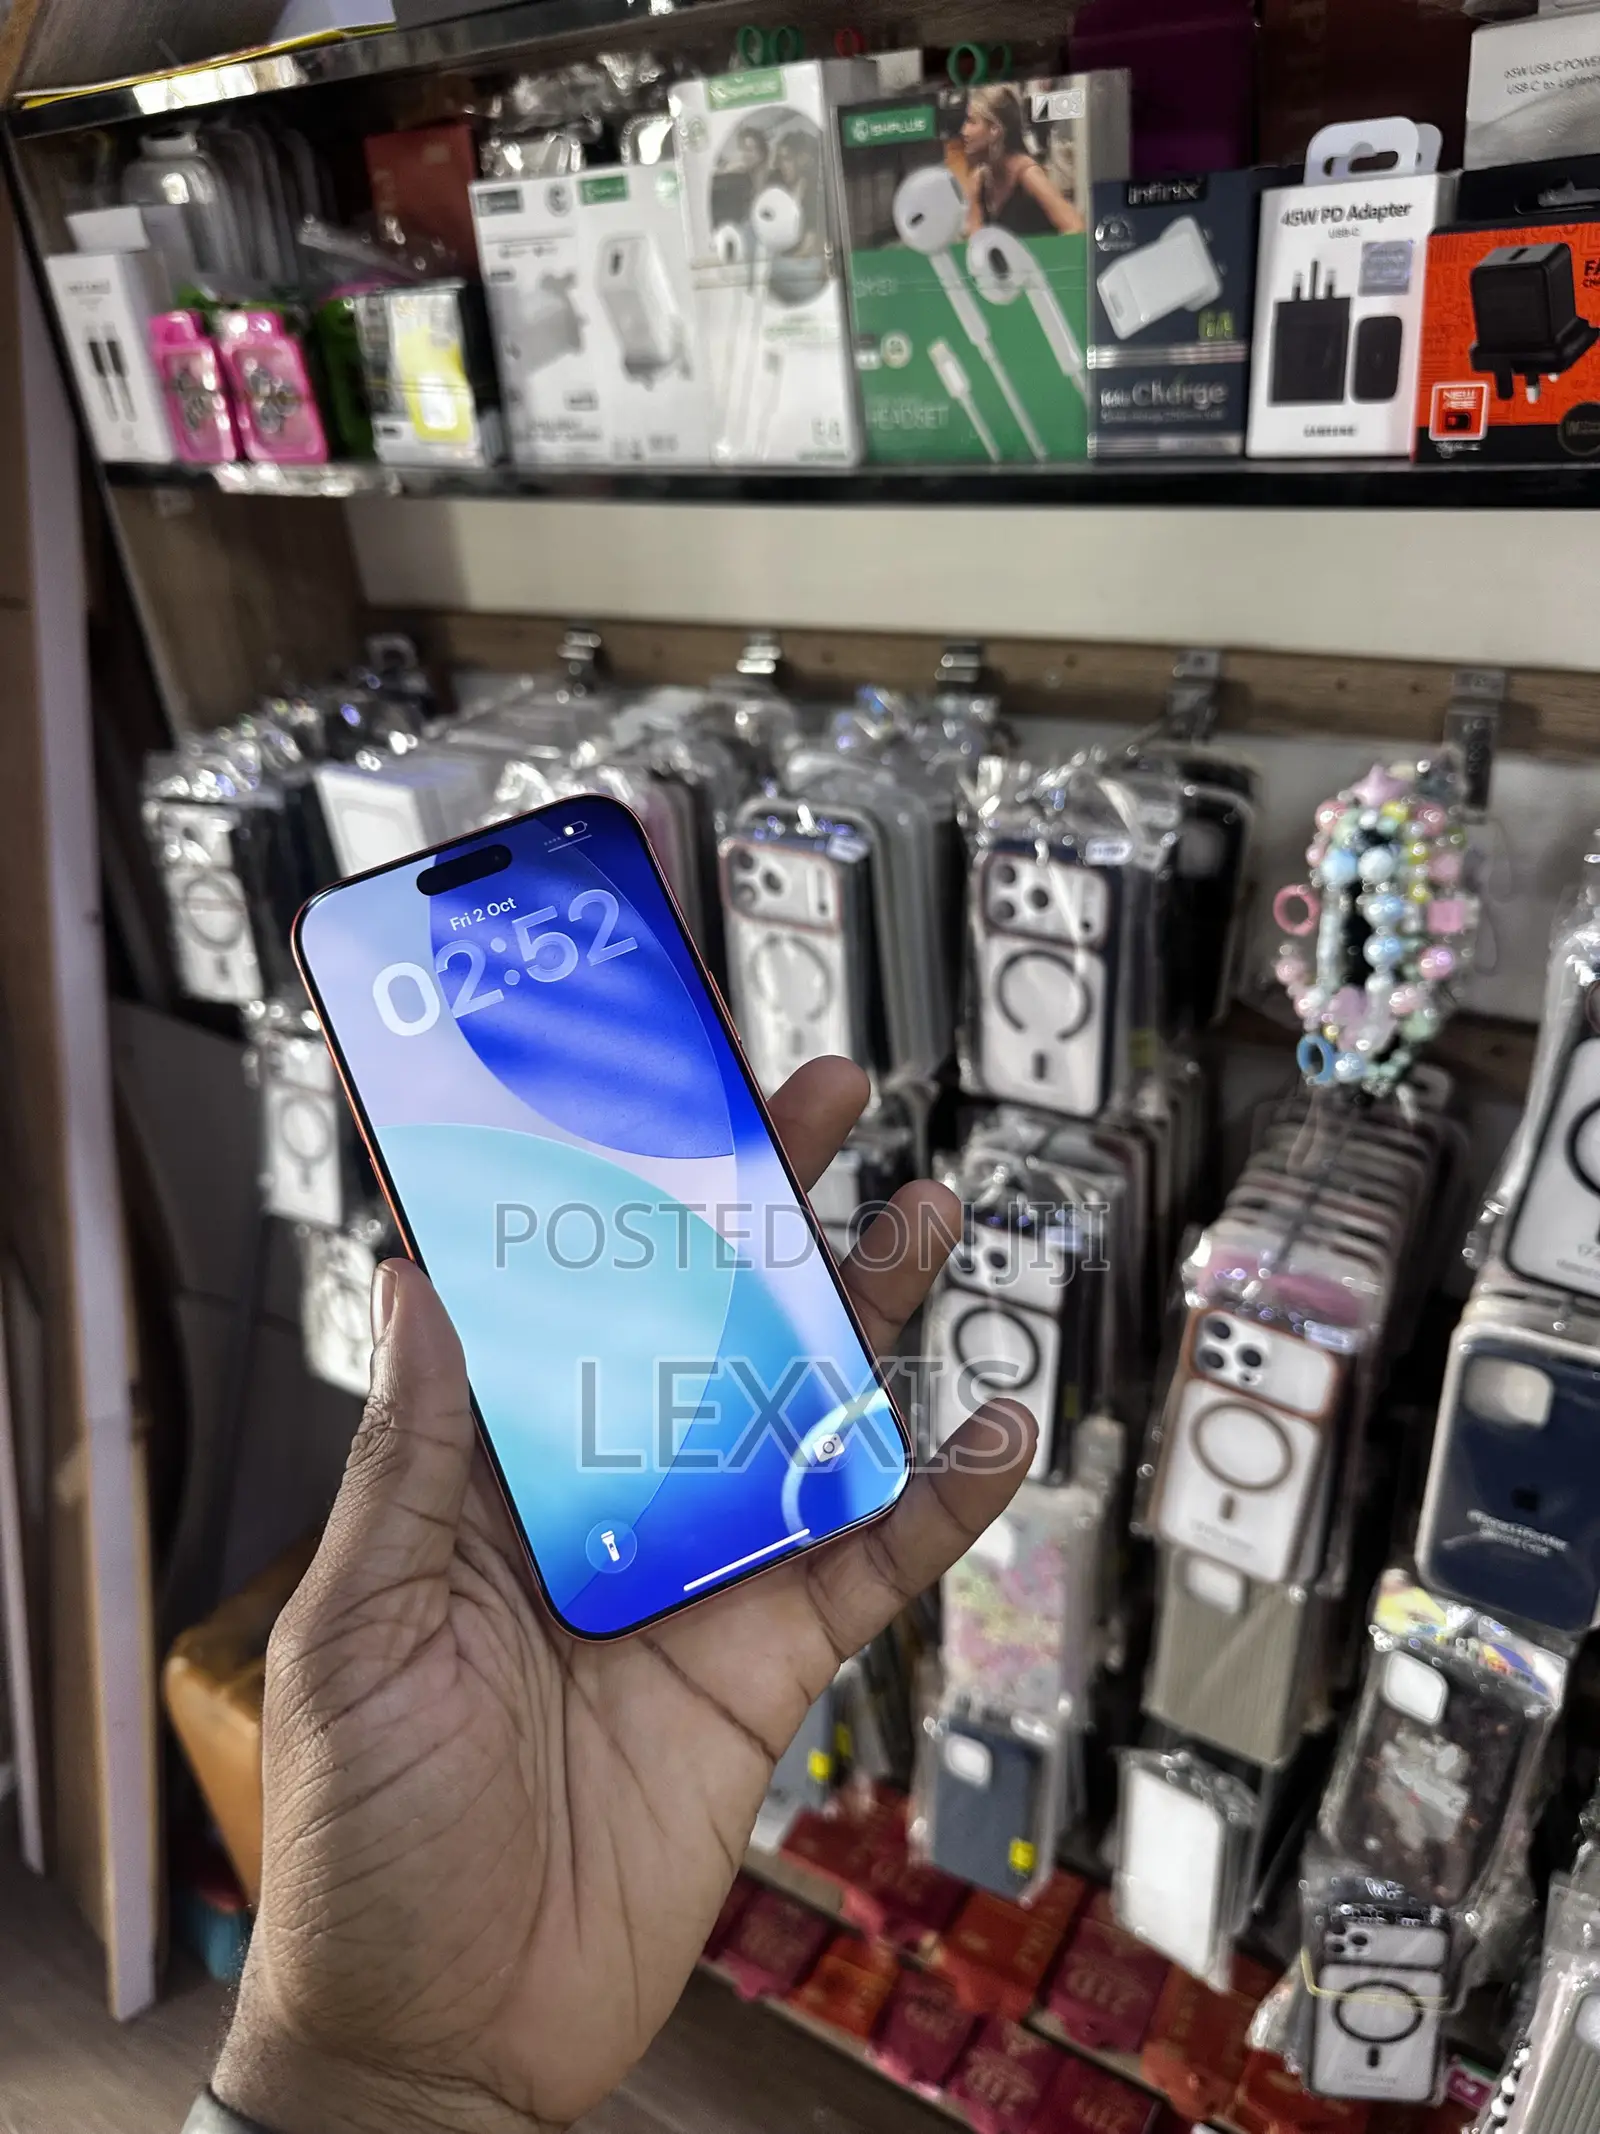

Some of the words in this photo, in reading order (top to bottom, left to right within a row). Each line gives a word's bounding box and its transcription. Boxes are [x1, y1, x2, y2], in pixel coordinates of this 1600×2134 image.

[1281, 206, 1318, 227] 45W
[1321, 205, 1344, 225] PD
[1346, 201, 1413, 224] Adapter
[1328, 227, 1361, 239] USB-C
[450, 912, 472, 932] Fri
[473, 908, 486, 923] 2
[487, 896, 517, 918] Oct
[372, 888, 639, 1037] 02:52
